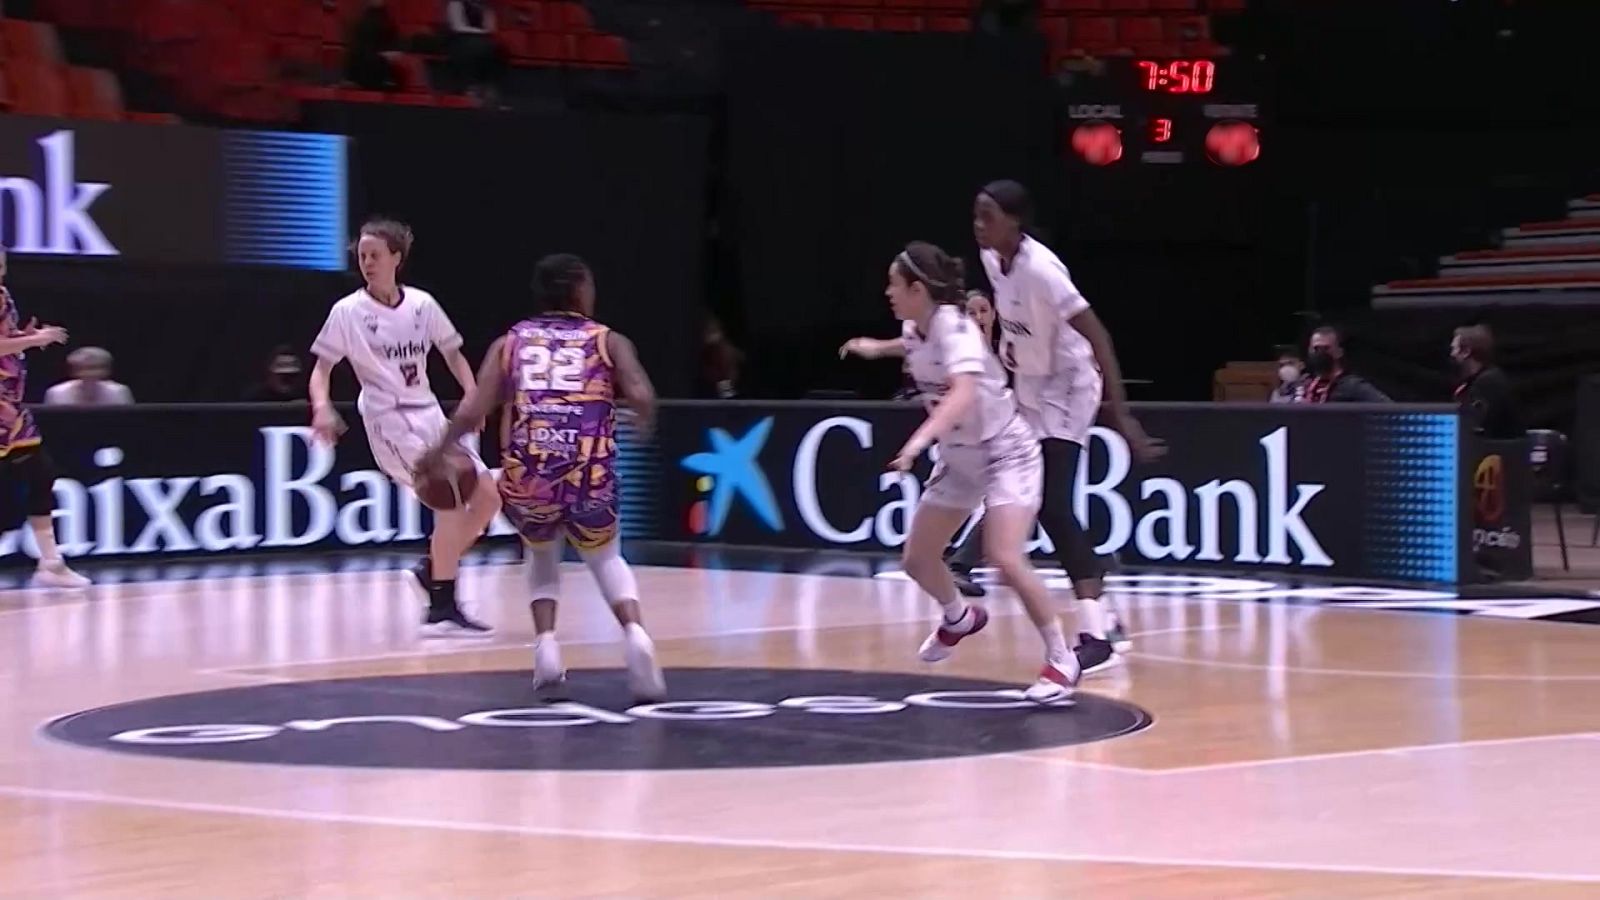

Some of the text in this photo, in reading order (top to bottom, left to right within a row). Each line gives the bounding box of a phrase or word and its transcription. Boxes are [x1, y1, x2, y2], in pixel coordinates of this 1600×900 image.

[1138, 60, 1216, 93] 7:50
[1154, 118, 1172, 142] 3
[399, 362, 421, 387] 12
[518, 345, 586, 391] 22
[0, 425, 520, 558] aixaBa
[792, 415, 1334, 567] CaBank
